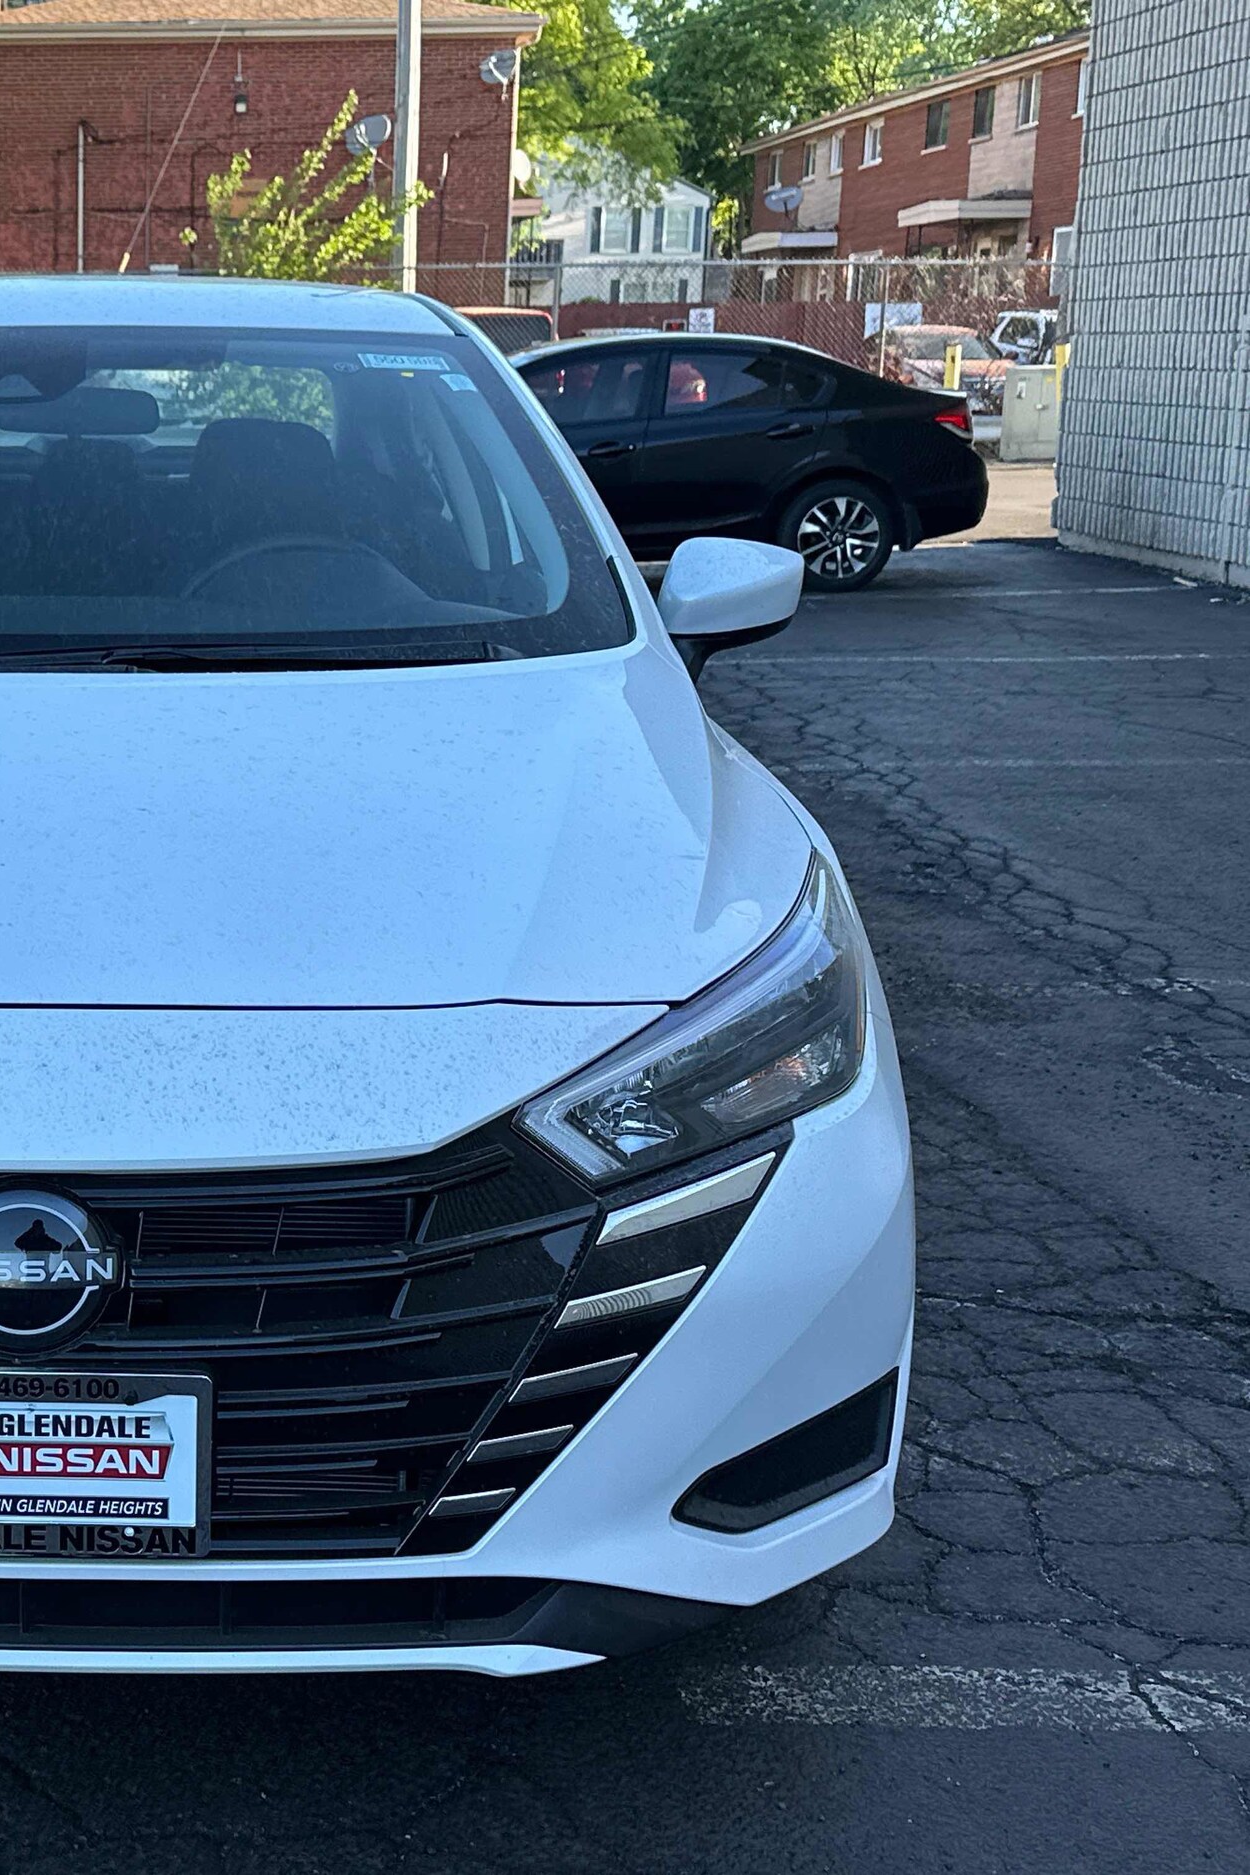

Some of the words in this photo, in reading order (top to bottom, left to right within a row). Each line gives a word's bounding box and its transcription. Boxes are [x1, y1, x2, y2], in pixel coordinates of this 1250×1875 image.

[16, 1498, 96, 1515] GLENDALE
[98, 1500, 164, 1516] HEIGHTS
[58, 1524, 197, 1556] NISSAN
